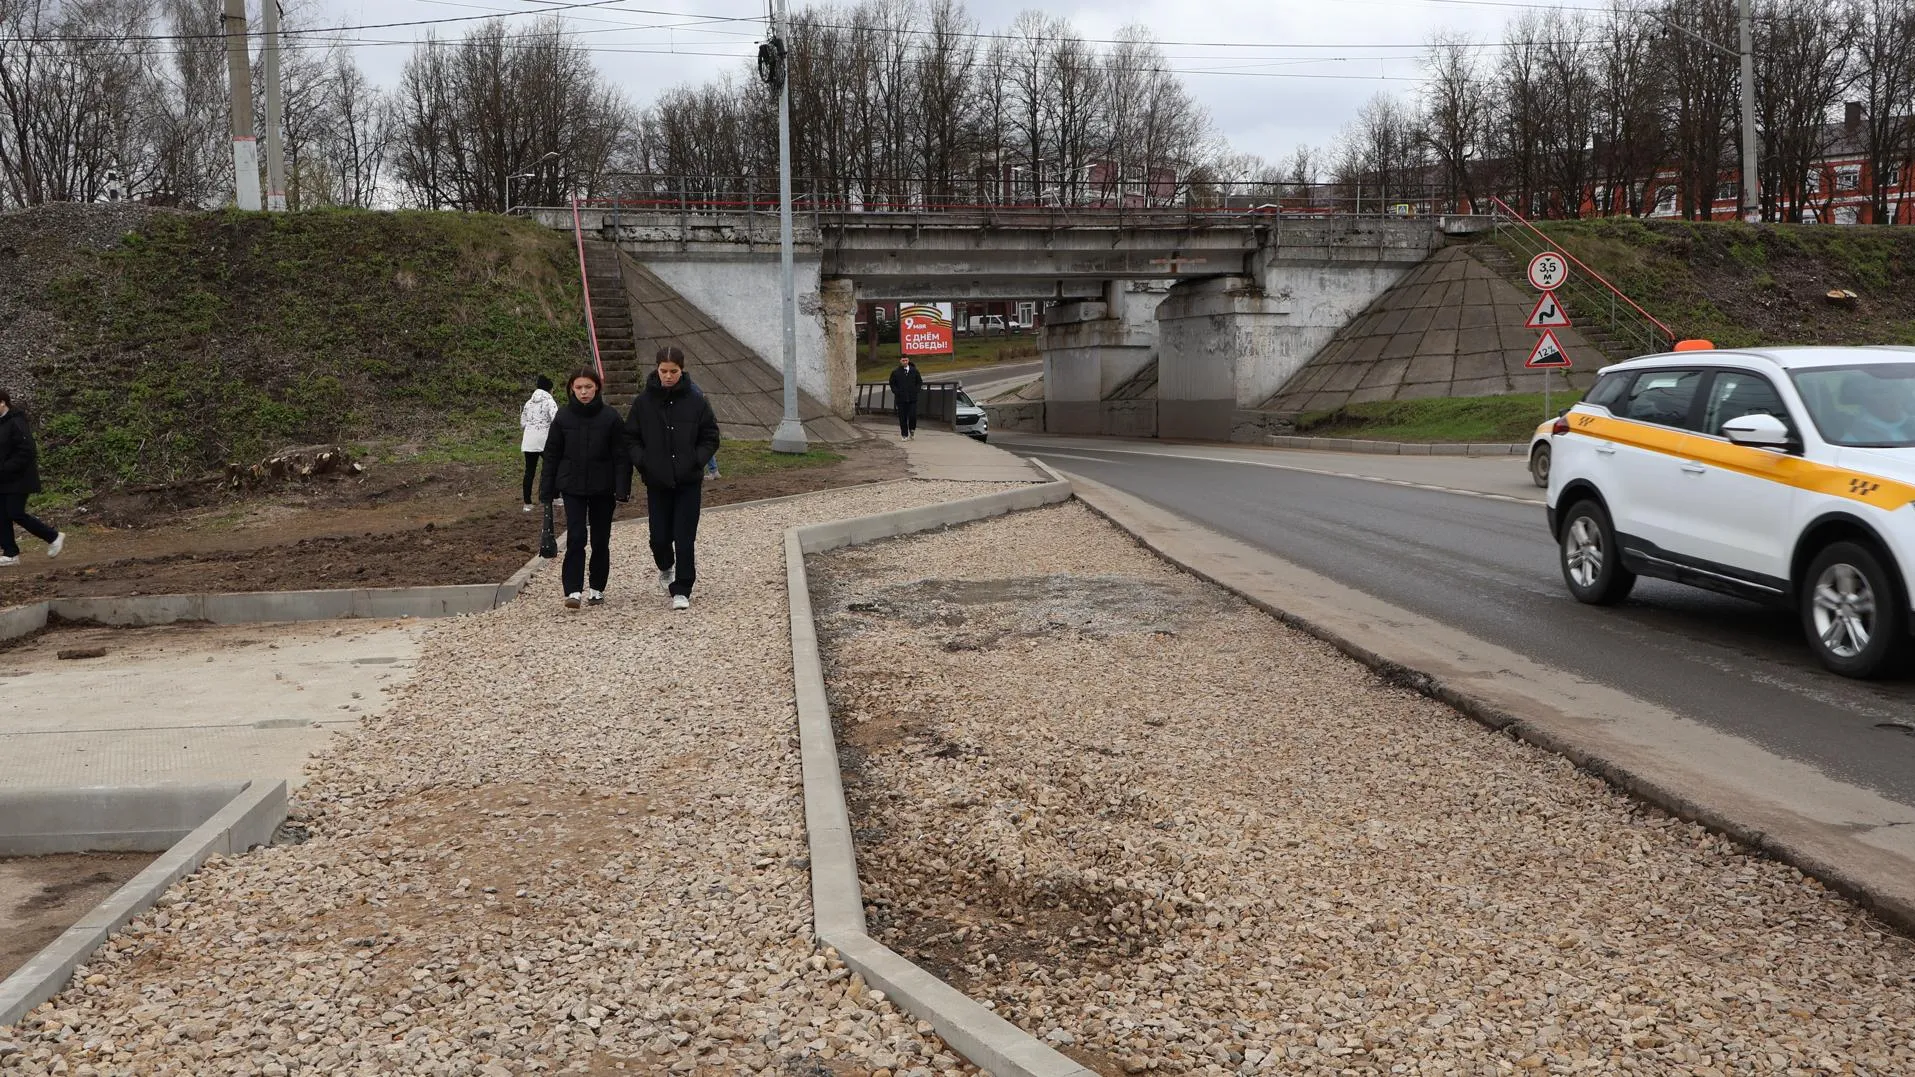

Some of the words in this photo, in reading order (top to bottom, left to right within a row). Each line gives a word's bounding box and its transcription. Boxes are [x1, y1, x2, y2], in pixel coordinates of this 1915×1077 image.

[1540, 262, 1556, 274] 3,5
[905, 318, 913, 329] 9
[913, 332, 940, 342] ДНЁМ
[906, 342, 948, 350] ПОБЕДЫ!
[1538, 346, 1556, 358] 12%
